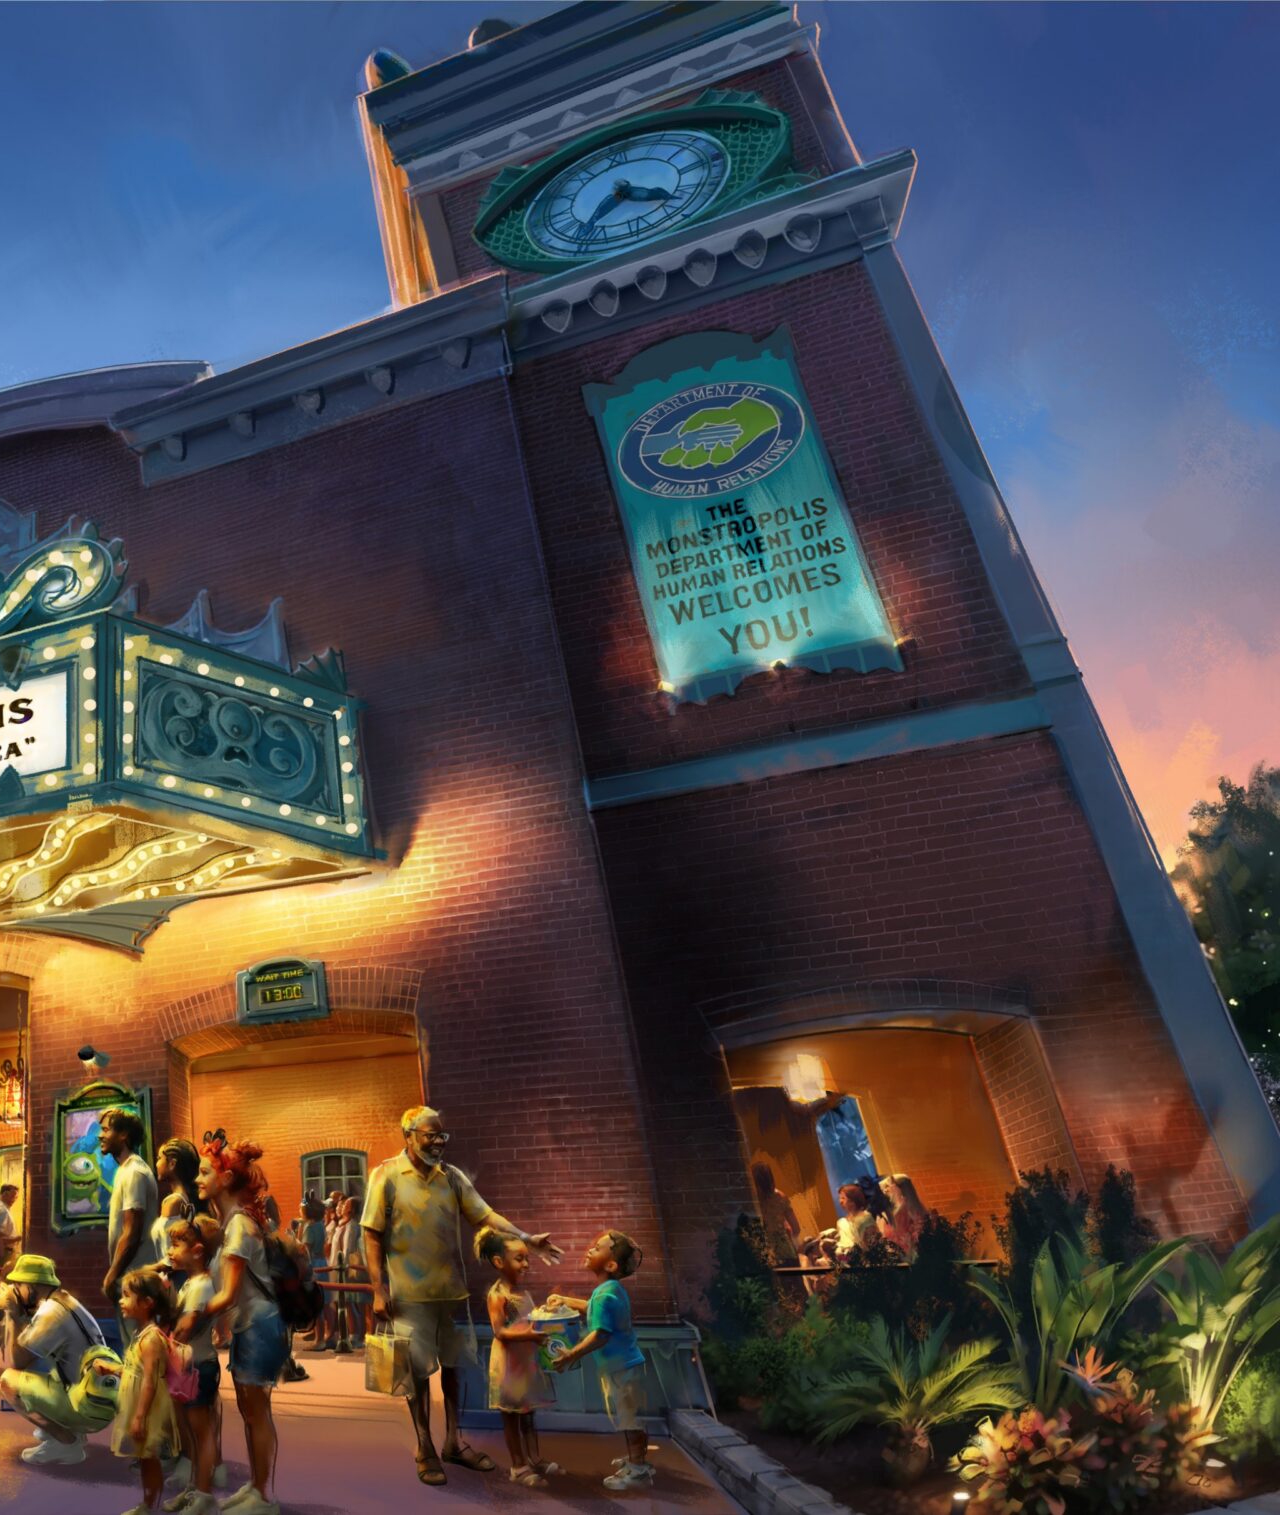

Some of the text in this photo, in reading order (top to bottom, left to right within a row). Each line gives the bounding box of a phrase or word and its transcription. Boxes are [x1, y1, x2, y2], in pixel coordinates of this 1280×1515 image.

[633, 383, 767, 433] DEPARTMENT OF
[650, 437, 794, 496] HUMAN RELATIONS
[646, 497, 829, 561] MONSTROPOLIS
[706, 498, 747, 521] THE
[652, 537, 847, 601] HUMAN RELATIONS
[655, 519, 828, 580] DEPARTMENT OF
[668, 563, 842, 625] WELCOMES
[718, 606, 815, 656] YOU!
[283, 969, 304, 978] TIME
